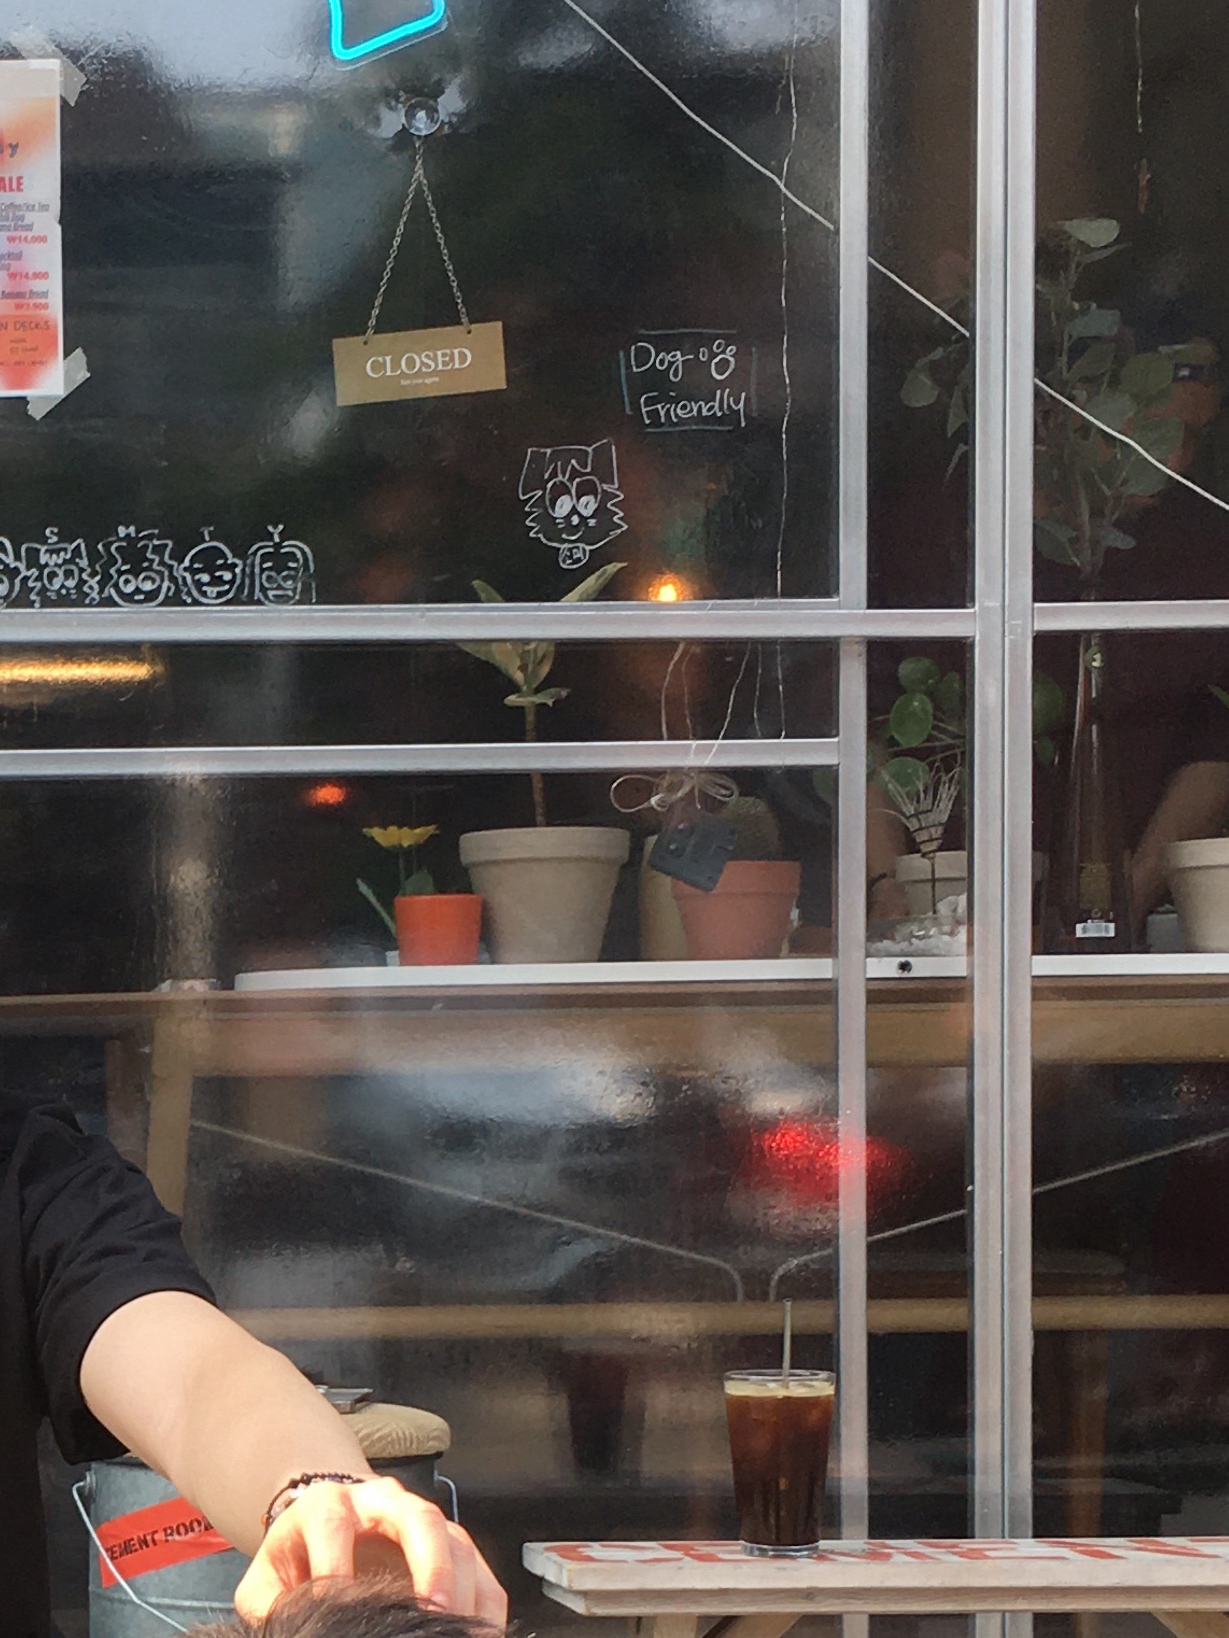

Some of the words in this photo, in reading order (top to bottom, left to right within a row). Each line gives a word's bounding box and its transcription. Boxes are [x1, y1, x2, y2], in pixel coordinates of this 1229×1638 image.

[366, 347, 472, 378] CLOSED
[631, 342, 695, 382] Dog
[640, 388, 746, 428] Friendly
[45, 527, 59, 543] S
[117, 525, 136, 538] M
[199, 526, 215, 541] T
[267, 524, 284, 542] Y
[544, 1537, 1229, 1563] CEMEN
